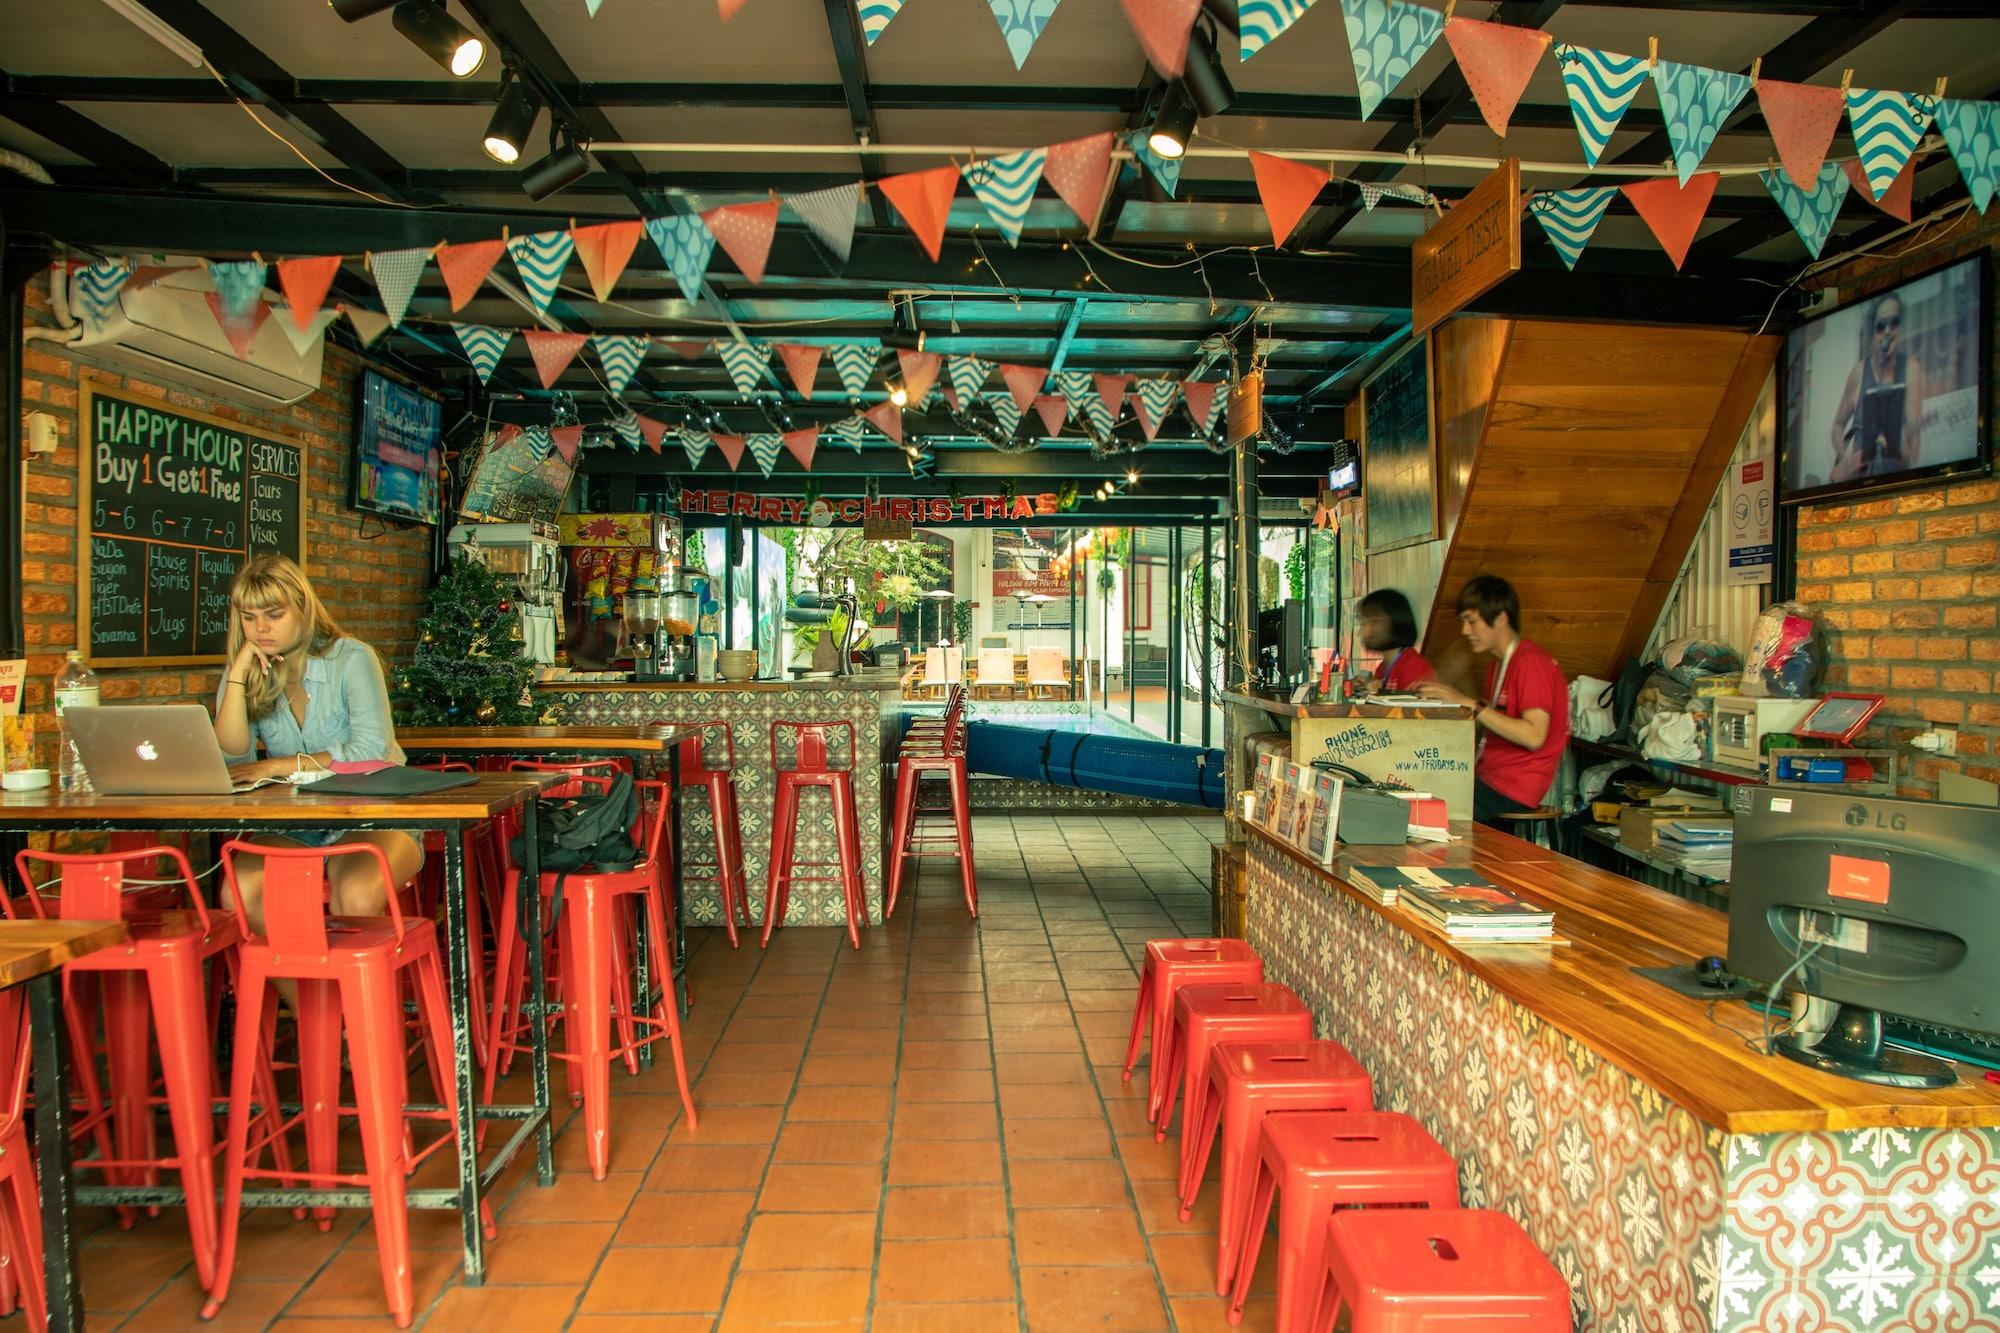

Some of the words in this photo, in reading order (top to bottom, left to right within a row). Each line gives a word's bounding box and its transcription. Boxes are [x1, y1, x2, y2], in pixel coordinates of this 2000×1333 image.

[1466, 198, 1503, 264] DESK
[97, 400, 179, 453] HAPPY
[183, 423, 243, 473] HOUR
[97, 443, 138, 494] Buy
[142, 453, 153, 484] 1
[157, 455, 200, 493] Get
[199, 466, 209, 494] 1
[210, 468, 241, 502] Free
[251, 443, 300, 476] SERVICES
[250, 475, 281, 499] Tours
[250, 500, 282, 522] Buses
[681, 488, 806, 523] MERRY
[839, 493, 1060, 523] CHRISTMAS
[250, 524, 278, 545] Visas
[868, 517, 910, 533] BAR
[150, 546, 187, 572] House
[199, 552, 235, 584] Tequila
[151, 568, 190, 595] Spirits
[150, 608, 185, 640] Jugs
[1325, 723, 1368, 749] PHONE
[1414, 747, 1440, 759] WEB
[1876, 810, 1907, 831] LG
